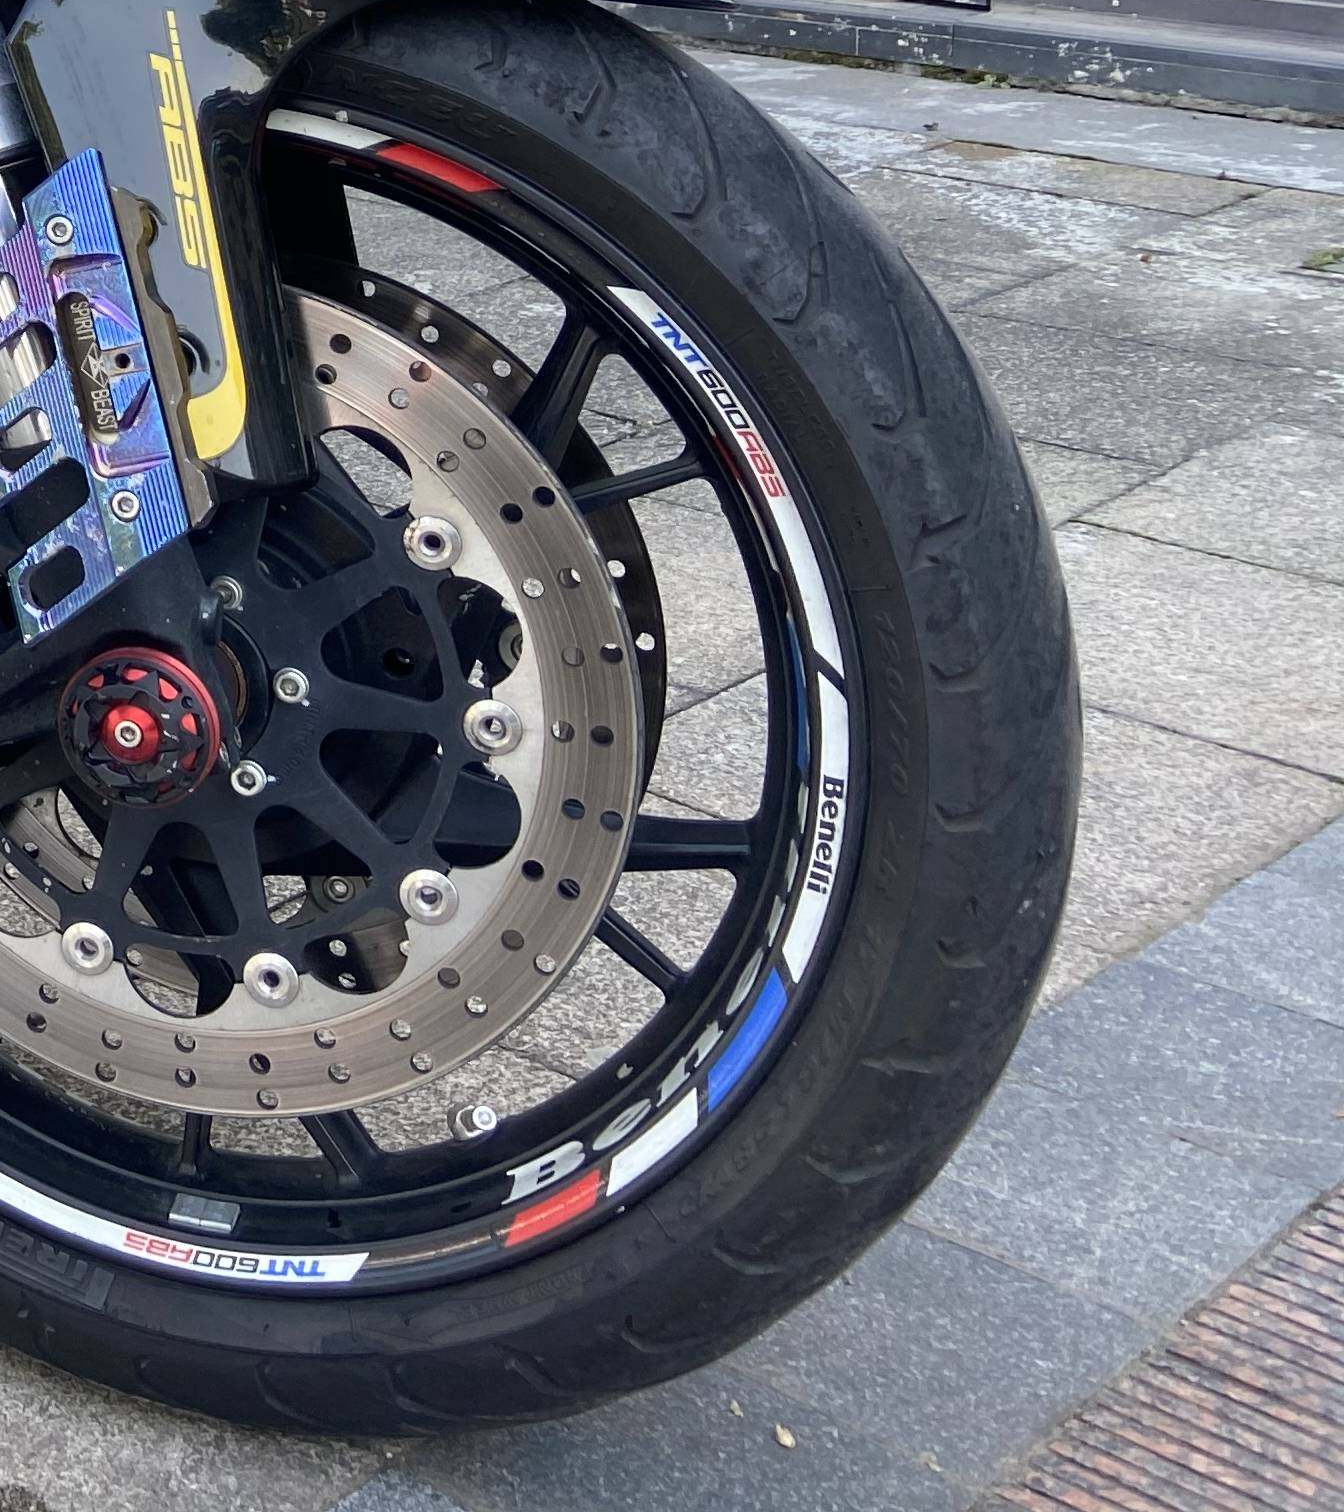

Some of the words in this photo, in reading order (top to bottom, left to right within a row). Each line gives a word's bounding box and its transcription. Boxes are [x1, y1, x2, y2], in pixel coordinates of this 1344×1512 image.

[148, 51, 208, 269] ABS
[69, 300, 95, 342] SPIRIT
[90, 390, 120, 431] BEAST
[648, 310, 787, 498] TNT600ABS
[805, 774, 845, 895] Benelli
[122, 1230, 326, 1278] TNT600ABS
